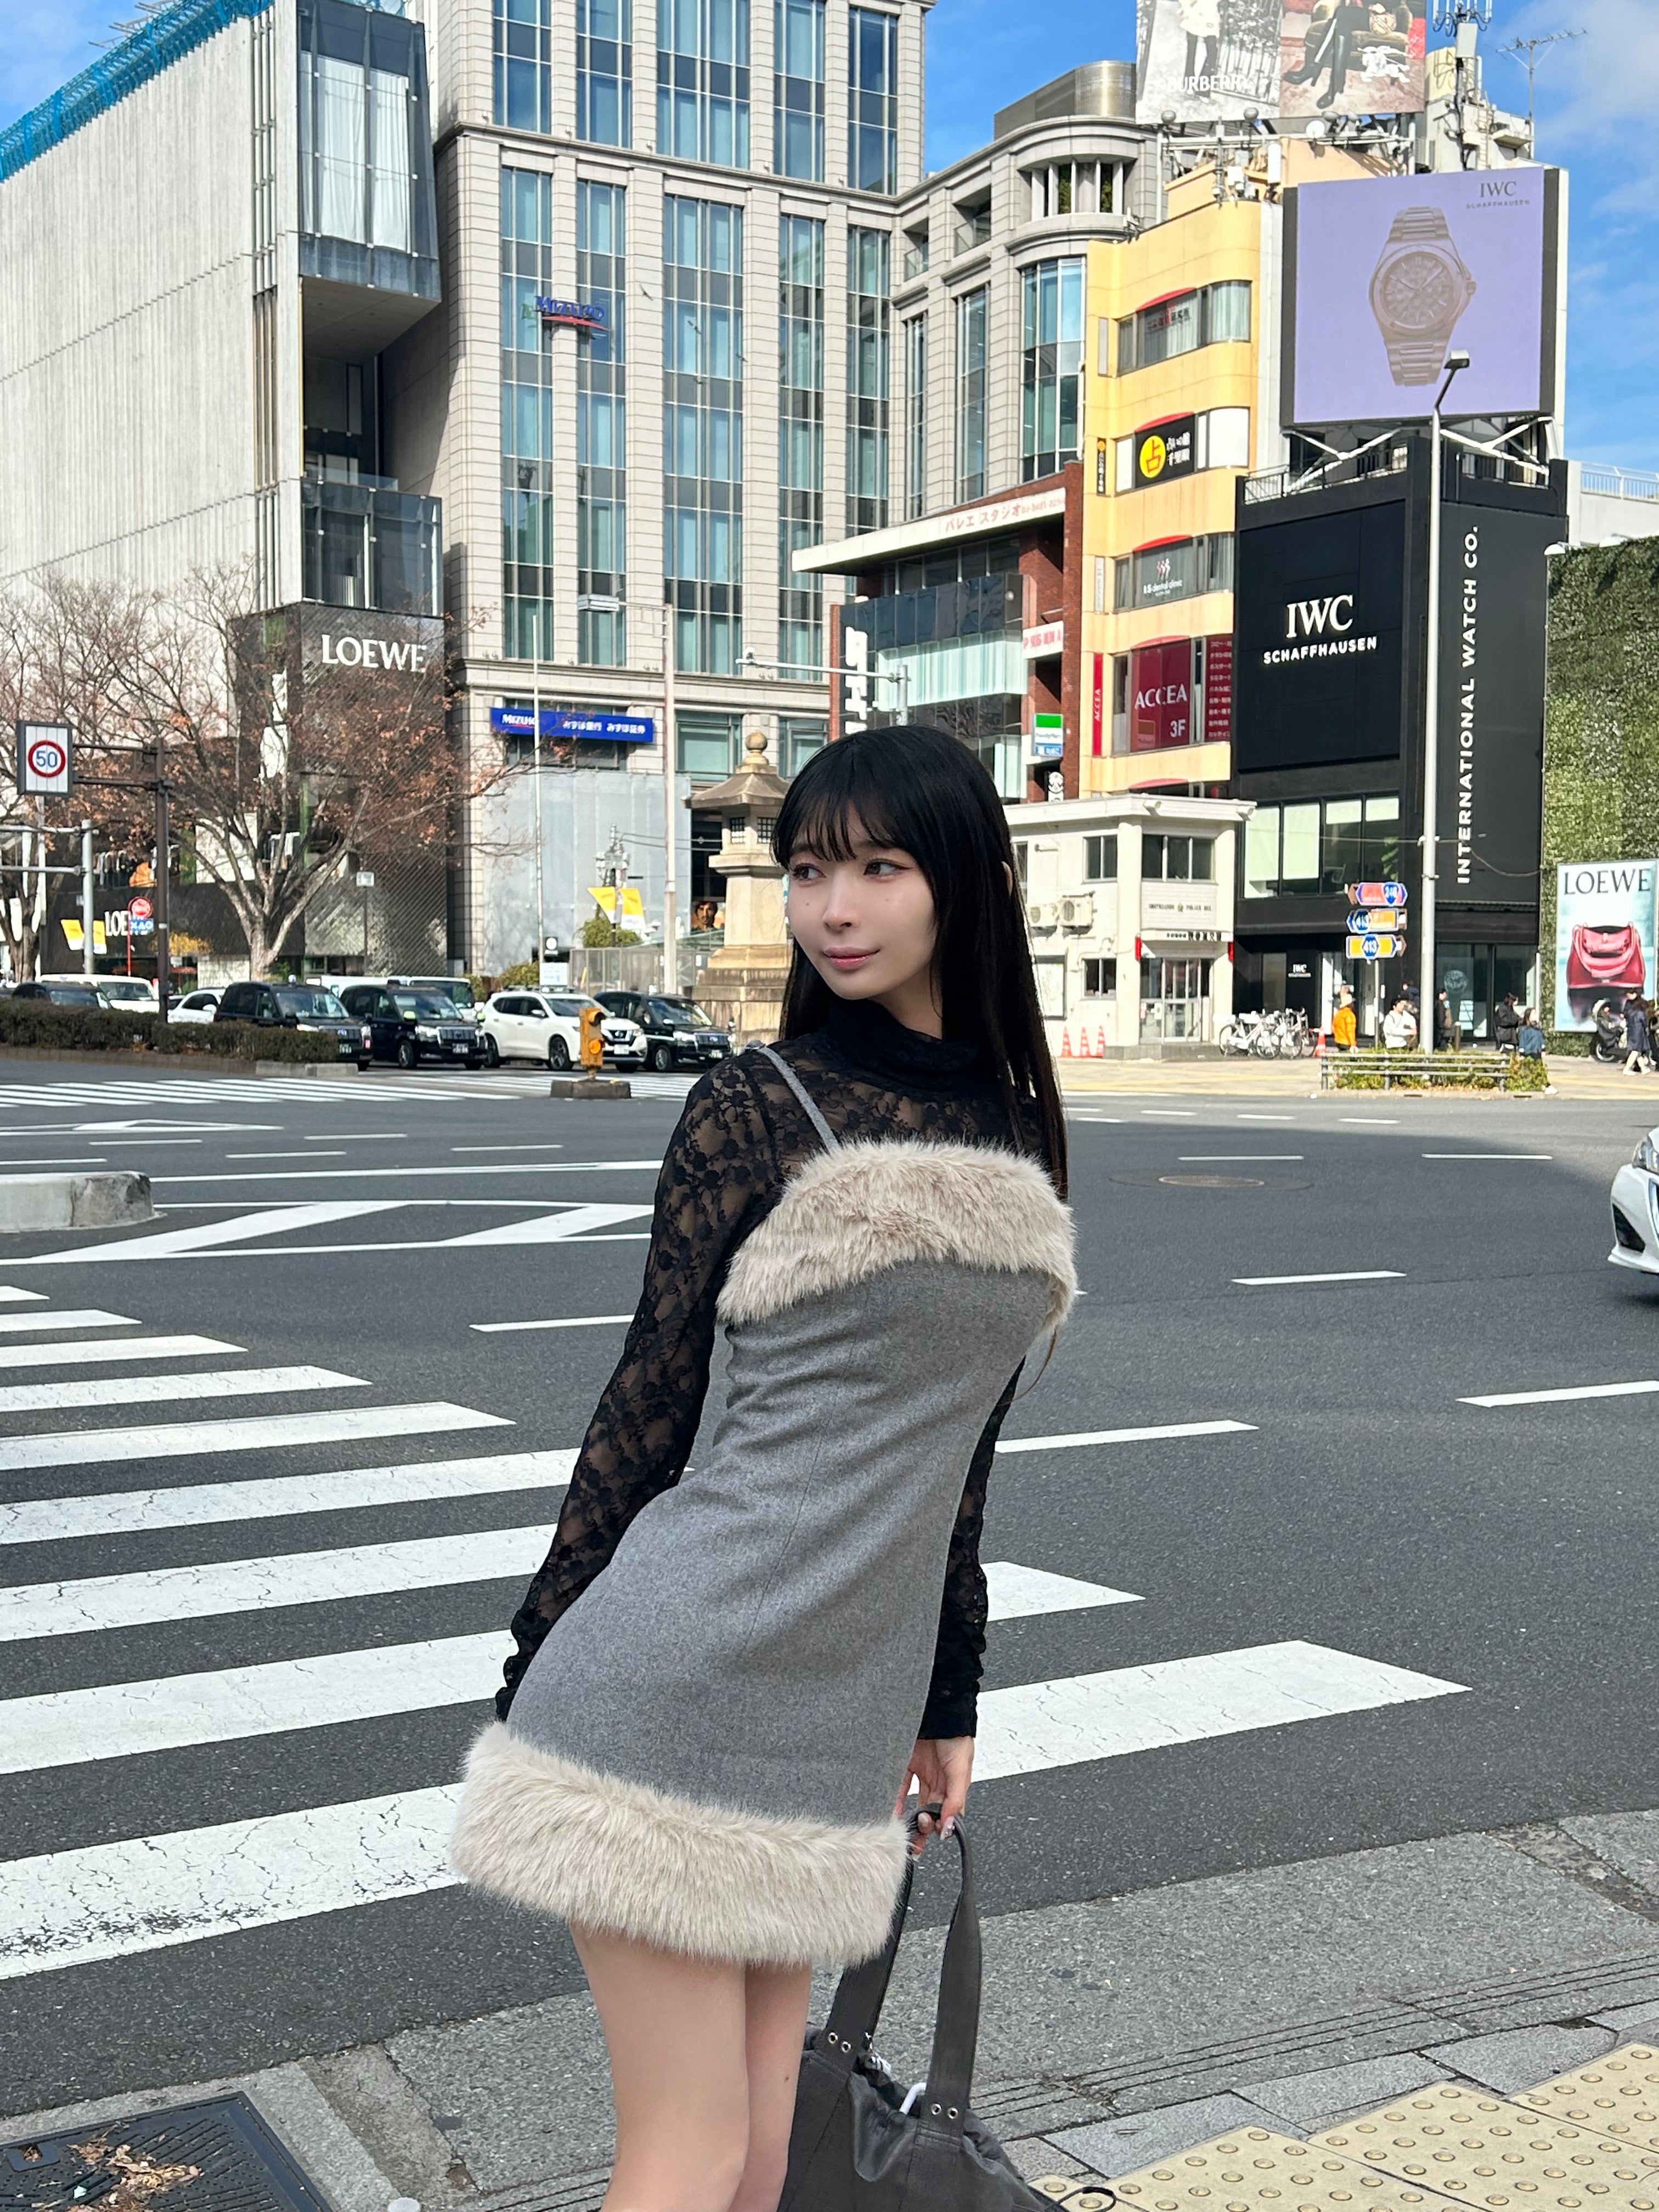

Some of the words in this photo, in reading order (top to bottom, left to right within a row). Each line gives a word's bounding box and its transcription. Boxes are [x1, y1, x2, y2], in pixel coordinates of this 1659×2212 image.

[1480, 181, 1517, 198] IWC
[1464, 526, 1479, 569] CO.
[1286, 595, 1353, 638] IWC
[1462, 579, 1477, 668] WATCH
[321, 634, 427, 673] LOEWE
[1263, 636, 1377, 664] SCHAFFHAUSEN
[1134, 683, 1188, 710] ACCEA
[1170, 719, 1186, 738] 3F
[36, 750, 58, 768] 50
[1457, 678, 1475, 884] INTERNATIONAL
[1564, 868, 1651, 895] LOEWE
[105, 910, 142, 936] LOE
[1363, 940, 1377, 953] 413
